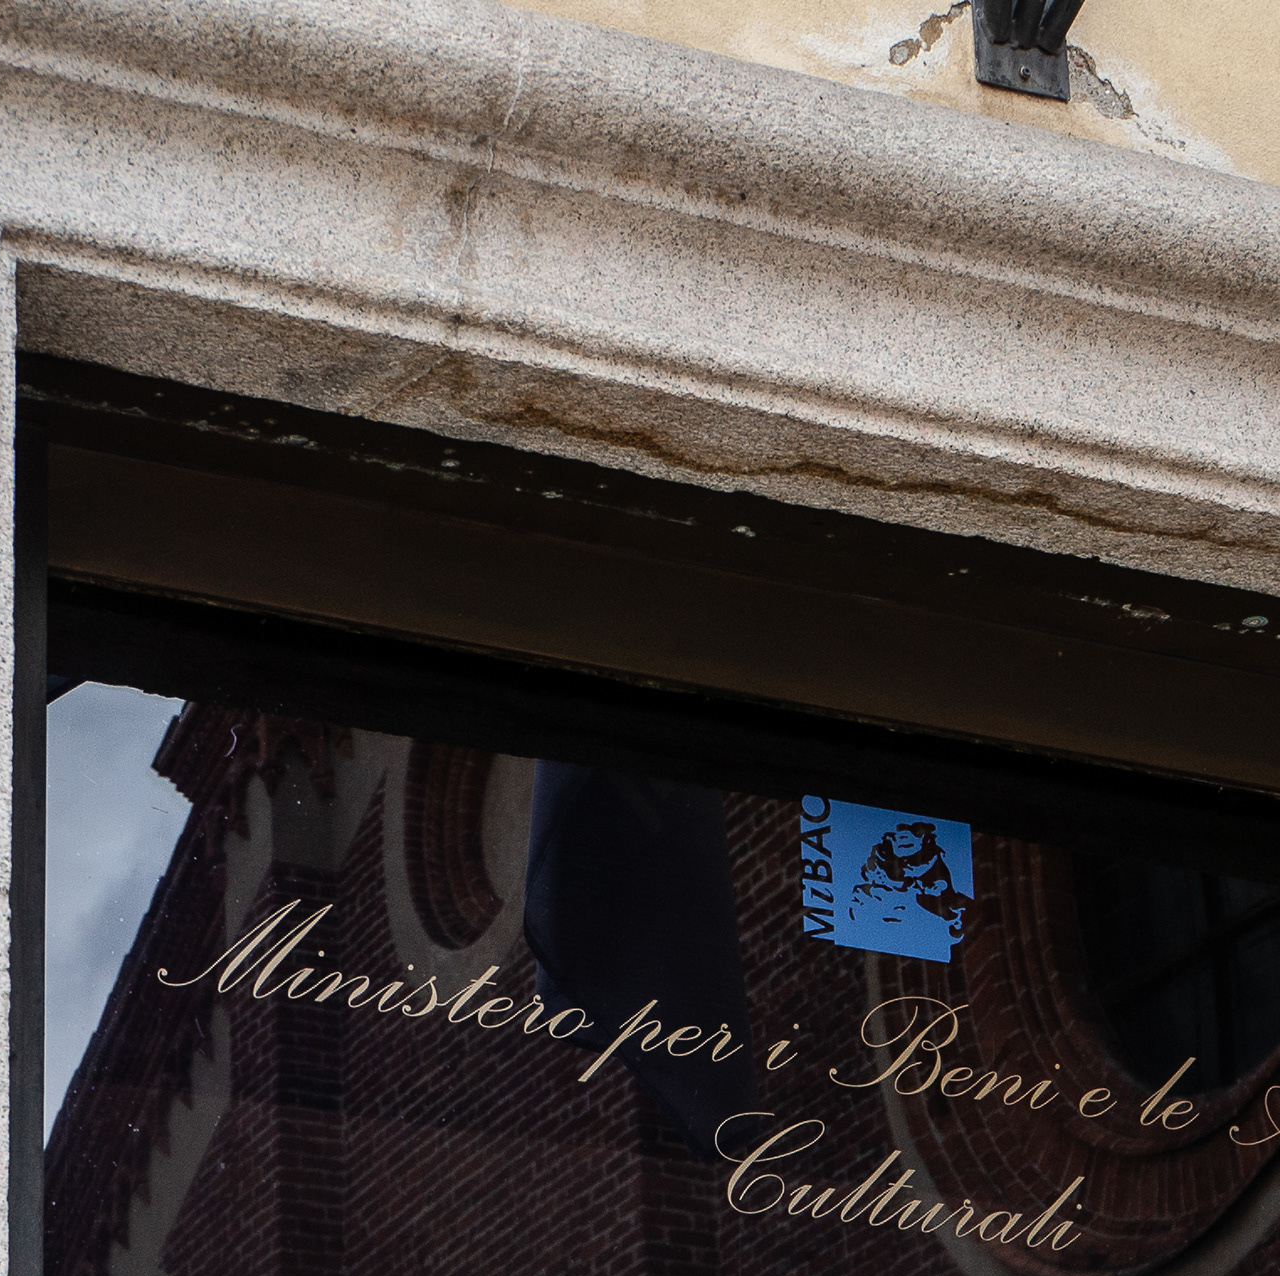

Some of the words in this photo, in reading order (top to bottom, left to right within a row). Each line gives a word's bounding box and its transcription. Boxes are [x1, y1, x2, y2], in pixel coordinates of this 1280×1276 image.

[157, 898, 595, 1040] Ministero
[578, 999, 744, 1082] per
[766, 1022, 800, 1071] i
[828, 995, 1062, 1110] Beni
[1079, 1086, 1117, 1117] e
[1140, 1056, 1200, 1129] le
[713, 1110, 1085, 1252] Culturali
